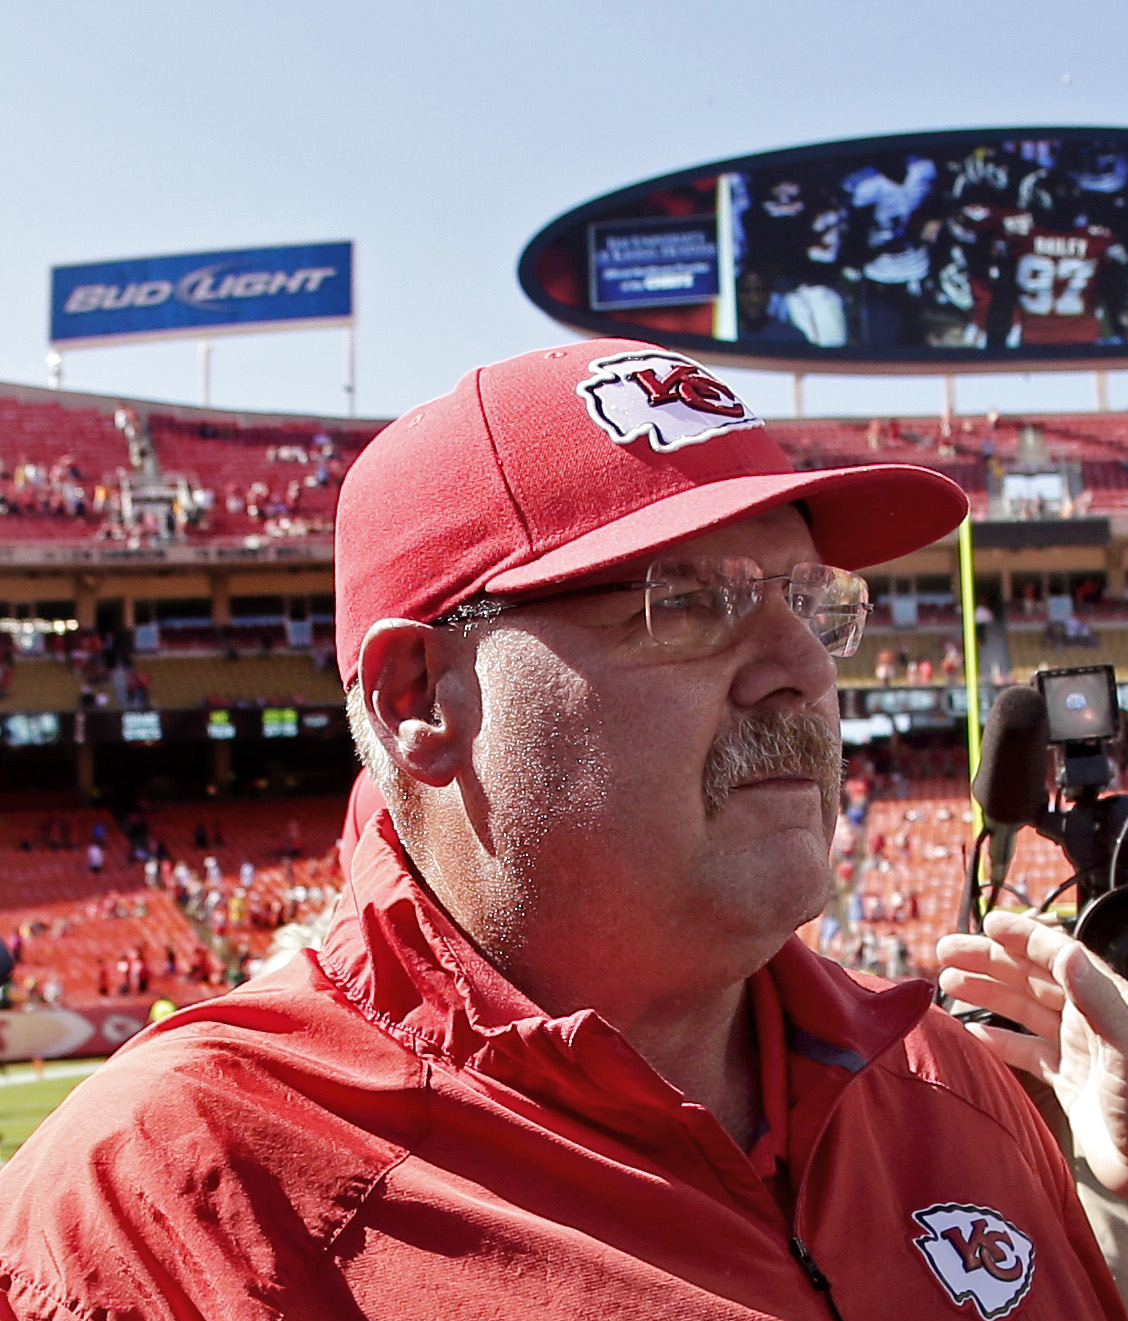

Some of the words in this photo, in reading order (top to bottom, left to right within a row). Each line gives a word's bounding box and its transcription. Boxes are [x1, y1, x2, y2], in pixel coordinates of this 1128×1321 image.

[65, 282, 173, 312] BUD
[194, 267, 336, 301] LIGHT
[1016, 253, 1098, 315] 97
[940, 1218, 1023, 1282] KC
